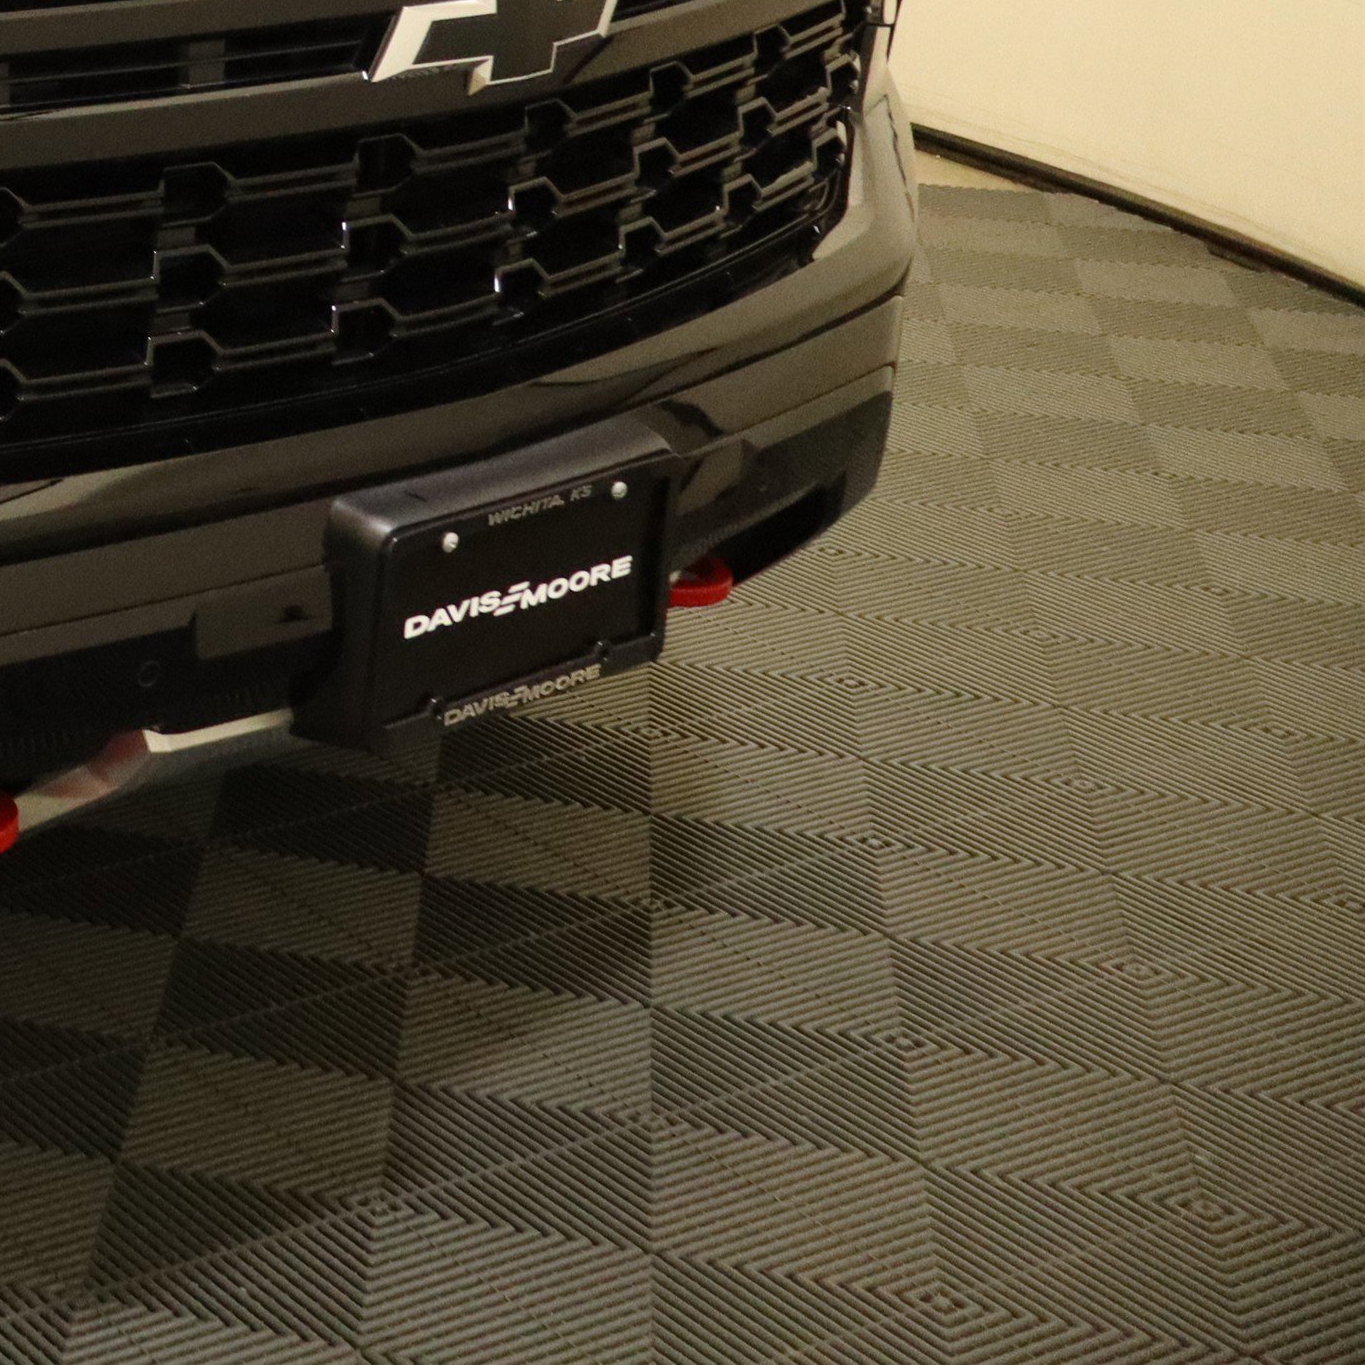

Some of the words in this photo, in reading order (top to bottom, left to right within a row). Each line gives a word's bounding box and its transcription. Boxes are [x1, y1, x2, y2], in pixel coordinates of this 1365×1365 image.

[570, 484, 593, 503] KS
[404, 590, 502, 640] DAVIS
[520, 554, 633, 610] MOORE
[444, 691, 510, 727] DAVIS
[522, 663, 602, 704] MOORE
